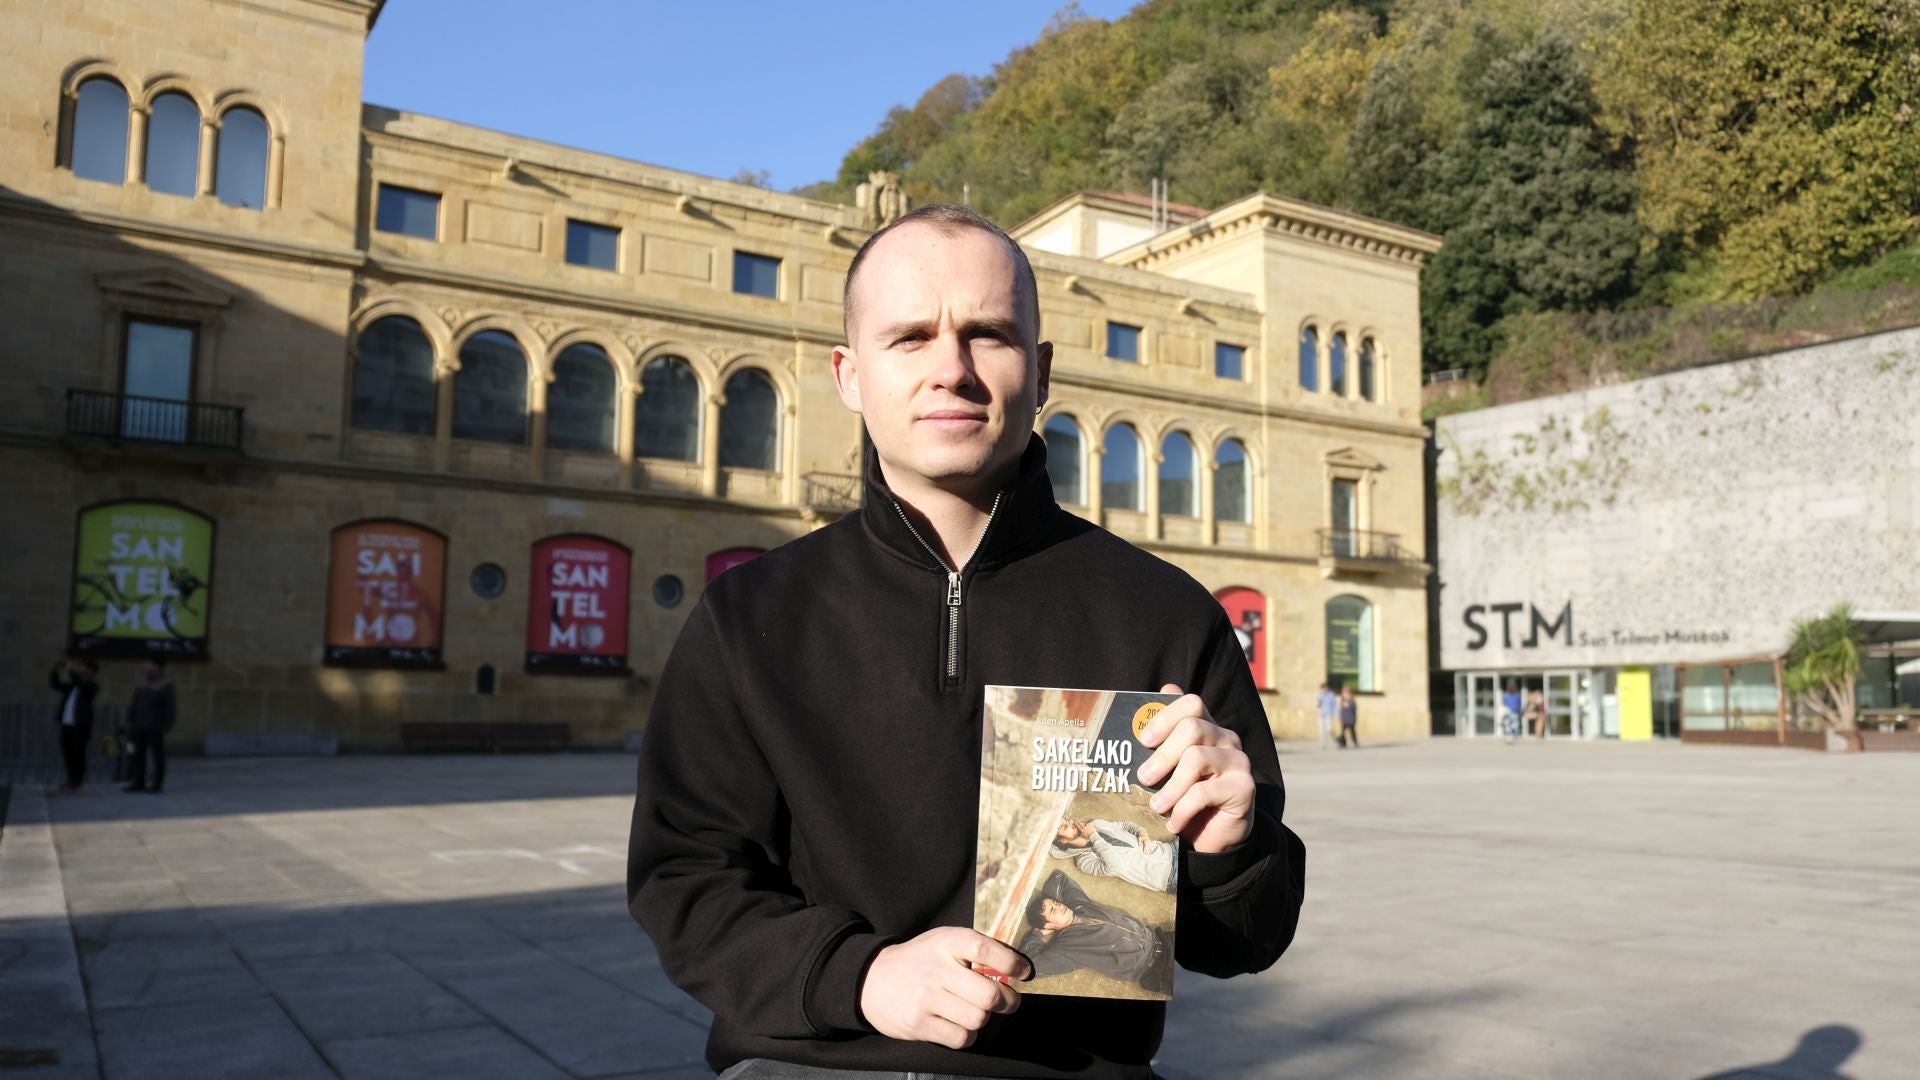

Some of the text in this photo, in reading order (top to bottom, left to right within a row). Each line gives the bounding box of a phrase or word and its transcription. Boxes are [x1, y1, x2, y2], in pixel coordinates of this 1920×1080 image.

[110, 531, 184, 561] SAN
[108, 565, 178, 596] TEL
[551, 562, 608, 588] SAN
[354, 580, 418, 609] TEL
[550, 590, 606, 618] TEL
[105, 600, 178, 632] MO
[353, 613, 416, 641] MO
[1463, 600, 1573, 650] STM
[549, 622, 604, 649] MO
[1035, 716, 1085, 728] Julen Apella
[1031, 736, 1132, 765] SAKELAKO
[1031, 765, 1131, 793] BIHOTZAK
